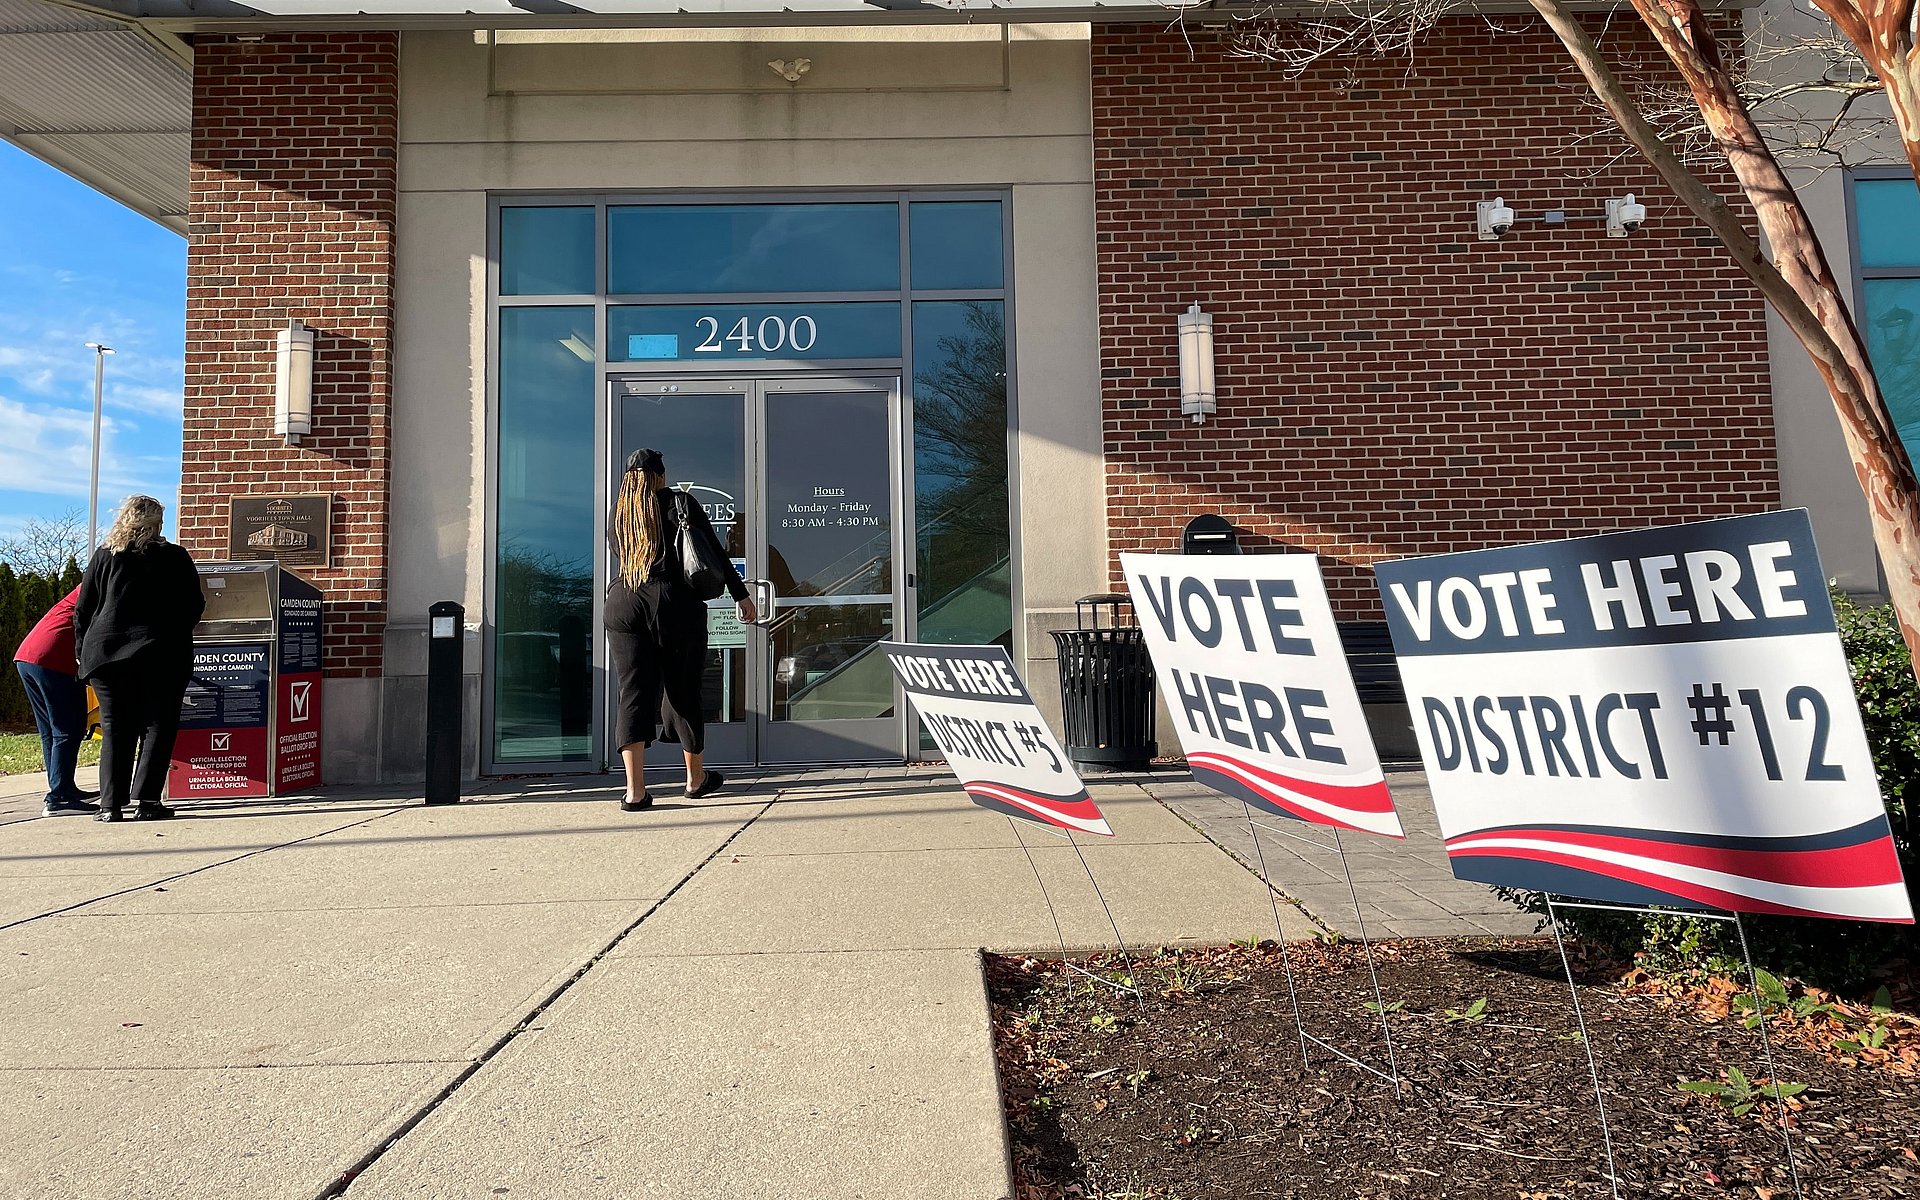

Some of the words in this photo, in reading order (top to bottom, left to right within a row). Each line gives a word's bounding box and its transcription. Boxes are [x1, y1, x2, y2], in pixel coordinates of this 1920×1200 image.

[694, 314, 818, 353] 2400
[814, 486, 845, 497] Hours
[787, 503, 828, 514] Monday
[840, 502, 871, 513] Friday
[782, 518, 805, 528] 8:30
[808, 518, 825, 527] AM
[836, 517, 860, 526] 4:30
[862, 516, 878, 526] PM
[281, 598, 301, 608] CAMDEN
[302, 600, 321, 608] COUNTY
[1390, 566, 1566, 642] VOTE
[1580, 540, 1807, 631] HERE
[1138, 574, 1316, 656] VOTE
[194, 654, 220, 663] MDEN
[222, 653, 264, 663] COUNTY
[888, 654, 954, 692] VOTE
[945, 658, 1022, 697] HERE
[1172, 667, 1348, 766] HERE
[280, 734, 297, 744] OFFICIAL
[298, 731, 317, 740] ELECTION
[924, 711, 1026, 768] DISTRICT
[1014, 720, 1062, 774] #5
[1422, 690, 1669, 781] DISTRICT
[1686, 682, 1847, 783] #12
[281, 744, 296, 754] BALLOT
